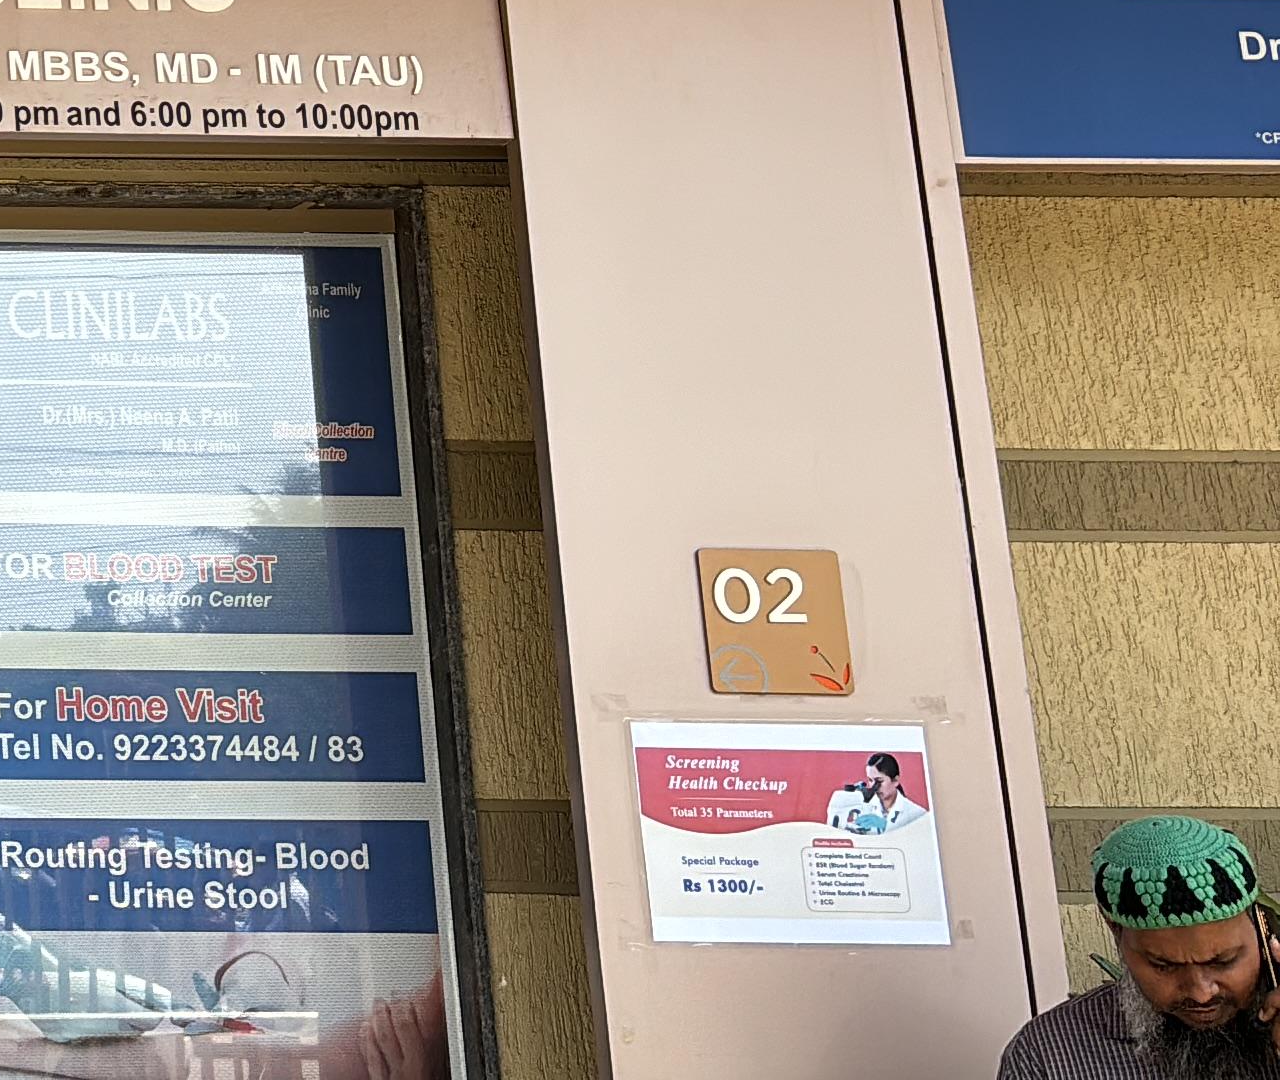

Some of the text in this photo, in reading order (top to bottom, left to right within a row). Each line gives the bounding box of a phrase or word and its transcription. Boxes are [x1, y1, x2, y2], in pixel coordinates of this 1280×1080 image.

[7, 49, 140, 87] MBBS,
[155, 52, 218, 84] MD
[257, 53, 303, 85] IM
[314, 54, 425, 95] (TAU)
[13, 103, 59, 132] pm
[66, 101, 121, 127] and
[130, 100, 193, 128] 6:00
[202, 105, 248, 134] pm
[256, 102, 286, 129] to
[295, 103, 421, 137] 10:00pm
[322, 282, 362, 300] Family
[7, 288, 230, 342] CLINILABS
[63, 552, 185, 583] BLOOD
[191, 553, 278, 584] TEST
[106, 588, 273, 609] Collection Center
[712, 567, 808, 624] 02
[55, 686, 169, 723] Home
[175, 687, 265, 724] Visit
[51, 733, 104, 761] No.
[113, 733, 300, 763] 9223374484
[327, 734, 365, 763] 83
[665, 754, 740, 774] Screening
[668, 775, 788, 795] Health Checkup
[670, 806, 774, 819] Total 35 Parameters
[0, 840, 127, 876] Routing
[275, 842, 370, 871] Blood
[681, 855, 759, 868] Special Package
[108, 880, 194, 909] Urine
[203, 880, 287, 910] Stool
[682, 878, 764, 896] Rs 1300/-
